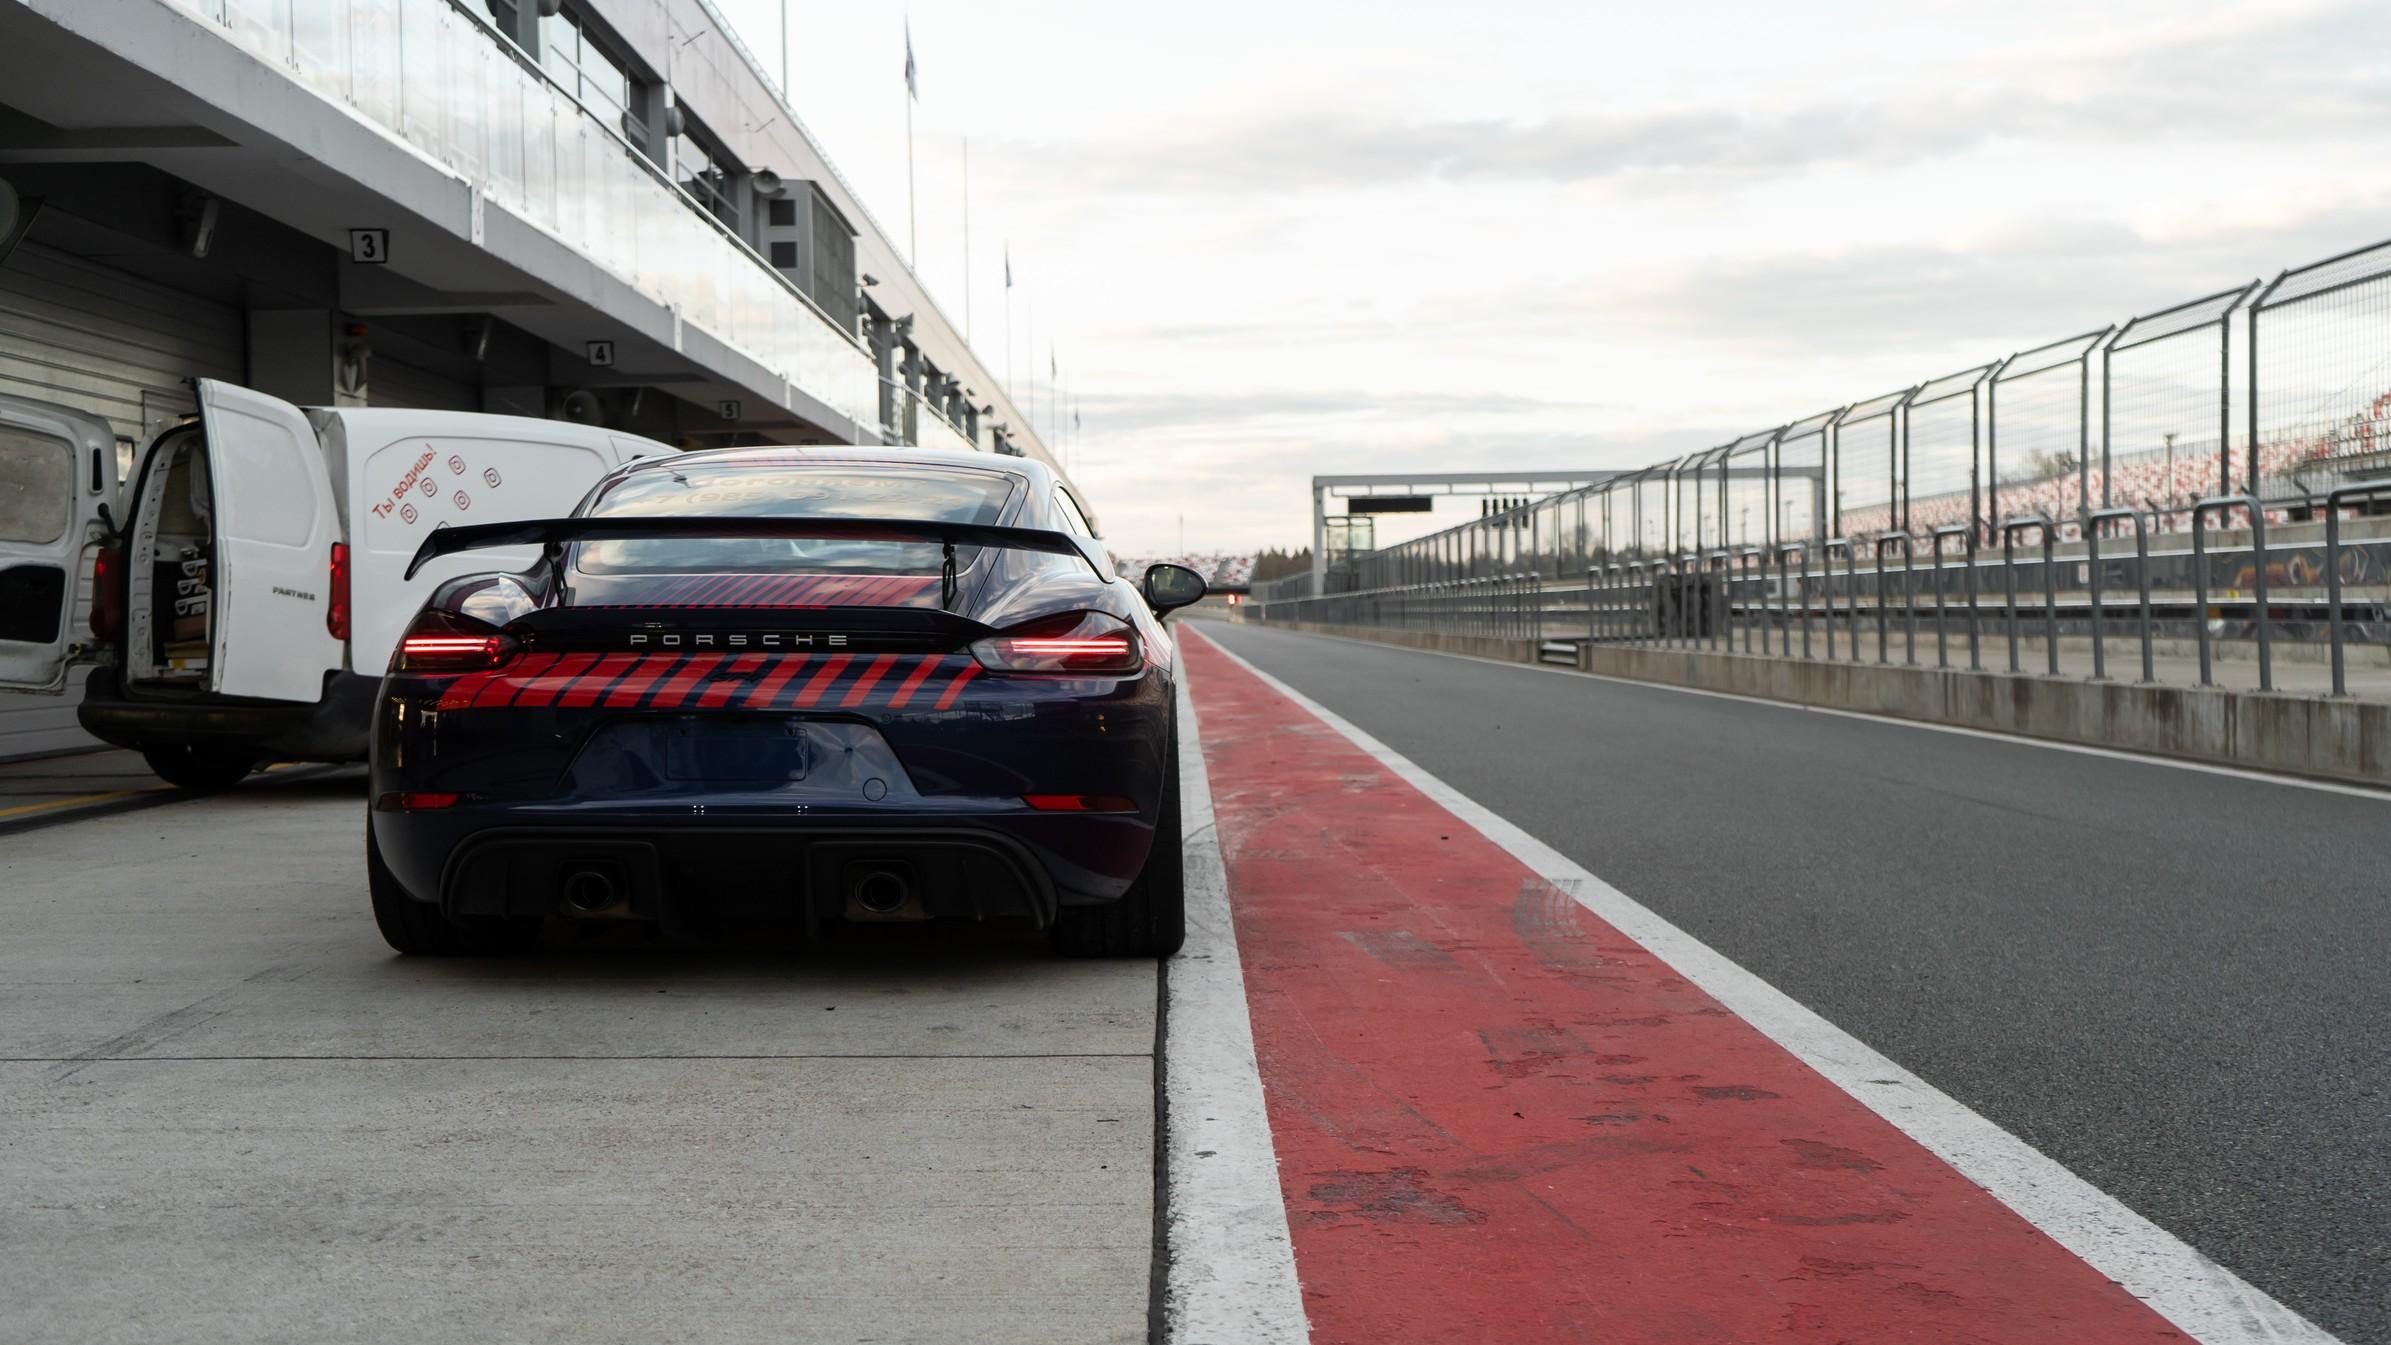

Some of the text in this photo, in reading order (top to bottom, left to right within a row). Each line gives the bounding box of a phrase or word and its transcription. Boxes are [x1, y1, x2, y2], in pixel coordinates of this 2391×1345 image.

[361, 233, 376, 259] 3
[595, 345, 606, 363] 4
[724, 403, 735, 418] 5
[372, 497, 396, 519] Ты
[272, 585, 316, 601] PARTNER
[630, 634, 848, 646] PORSCHE
